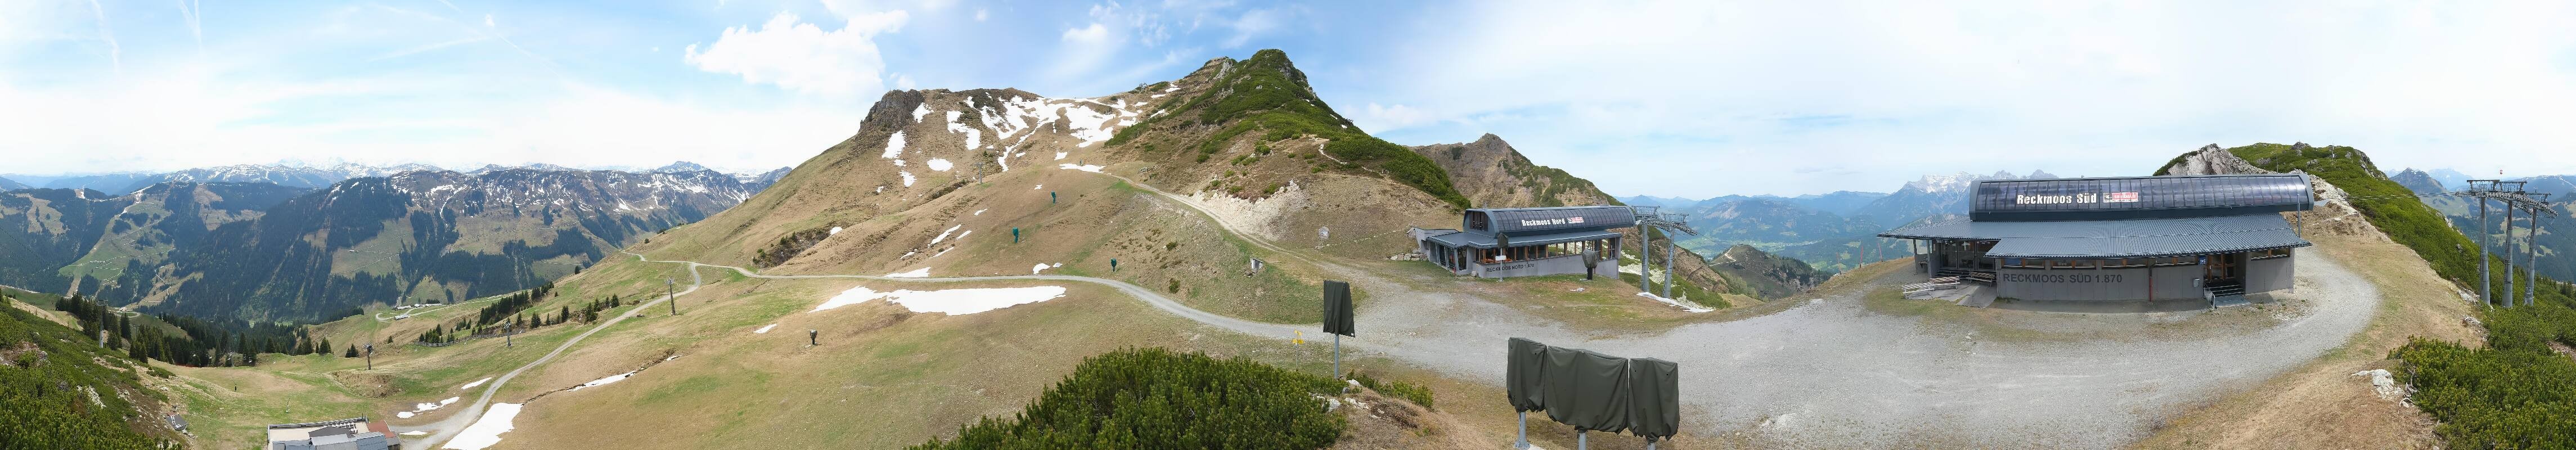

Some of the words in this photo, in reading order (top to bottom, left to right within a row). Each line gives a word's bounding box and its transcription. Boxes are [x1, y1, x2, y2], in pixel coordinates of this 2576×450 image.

[2017, 194, 2072, 204] Reckmoos
[2076, 192, 2097, 204] Süd
[2003, 273, 2065, 283] RECKMOOS
[2069, 273, 2092, 283] SÜD
[2095, 274, 2123, 283] 1.870
